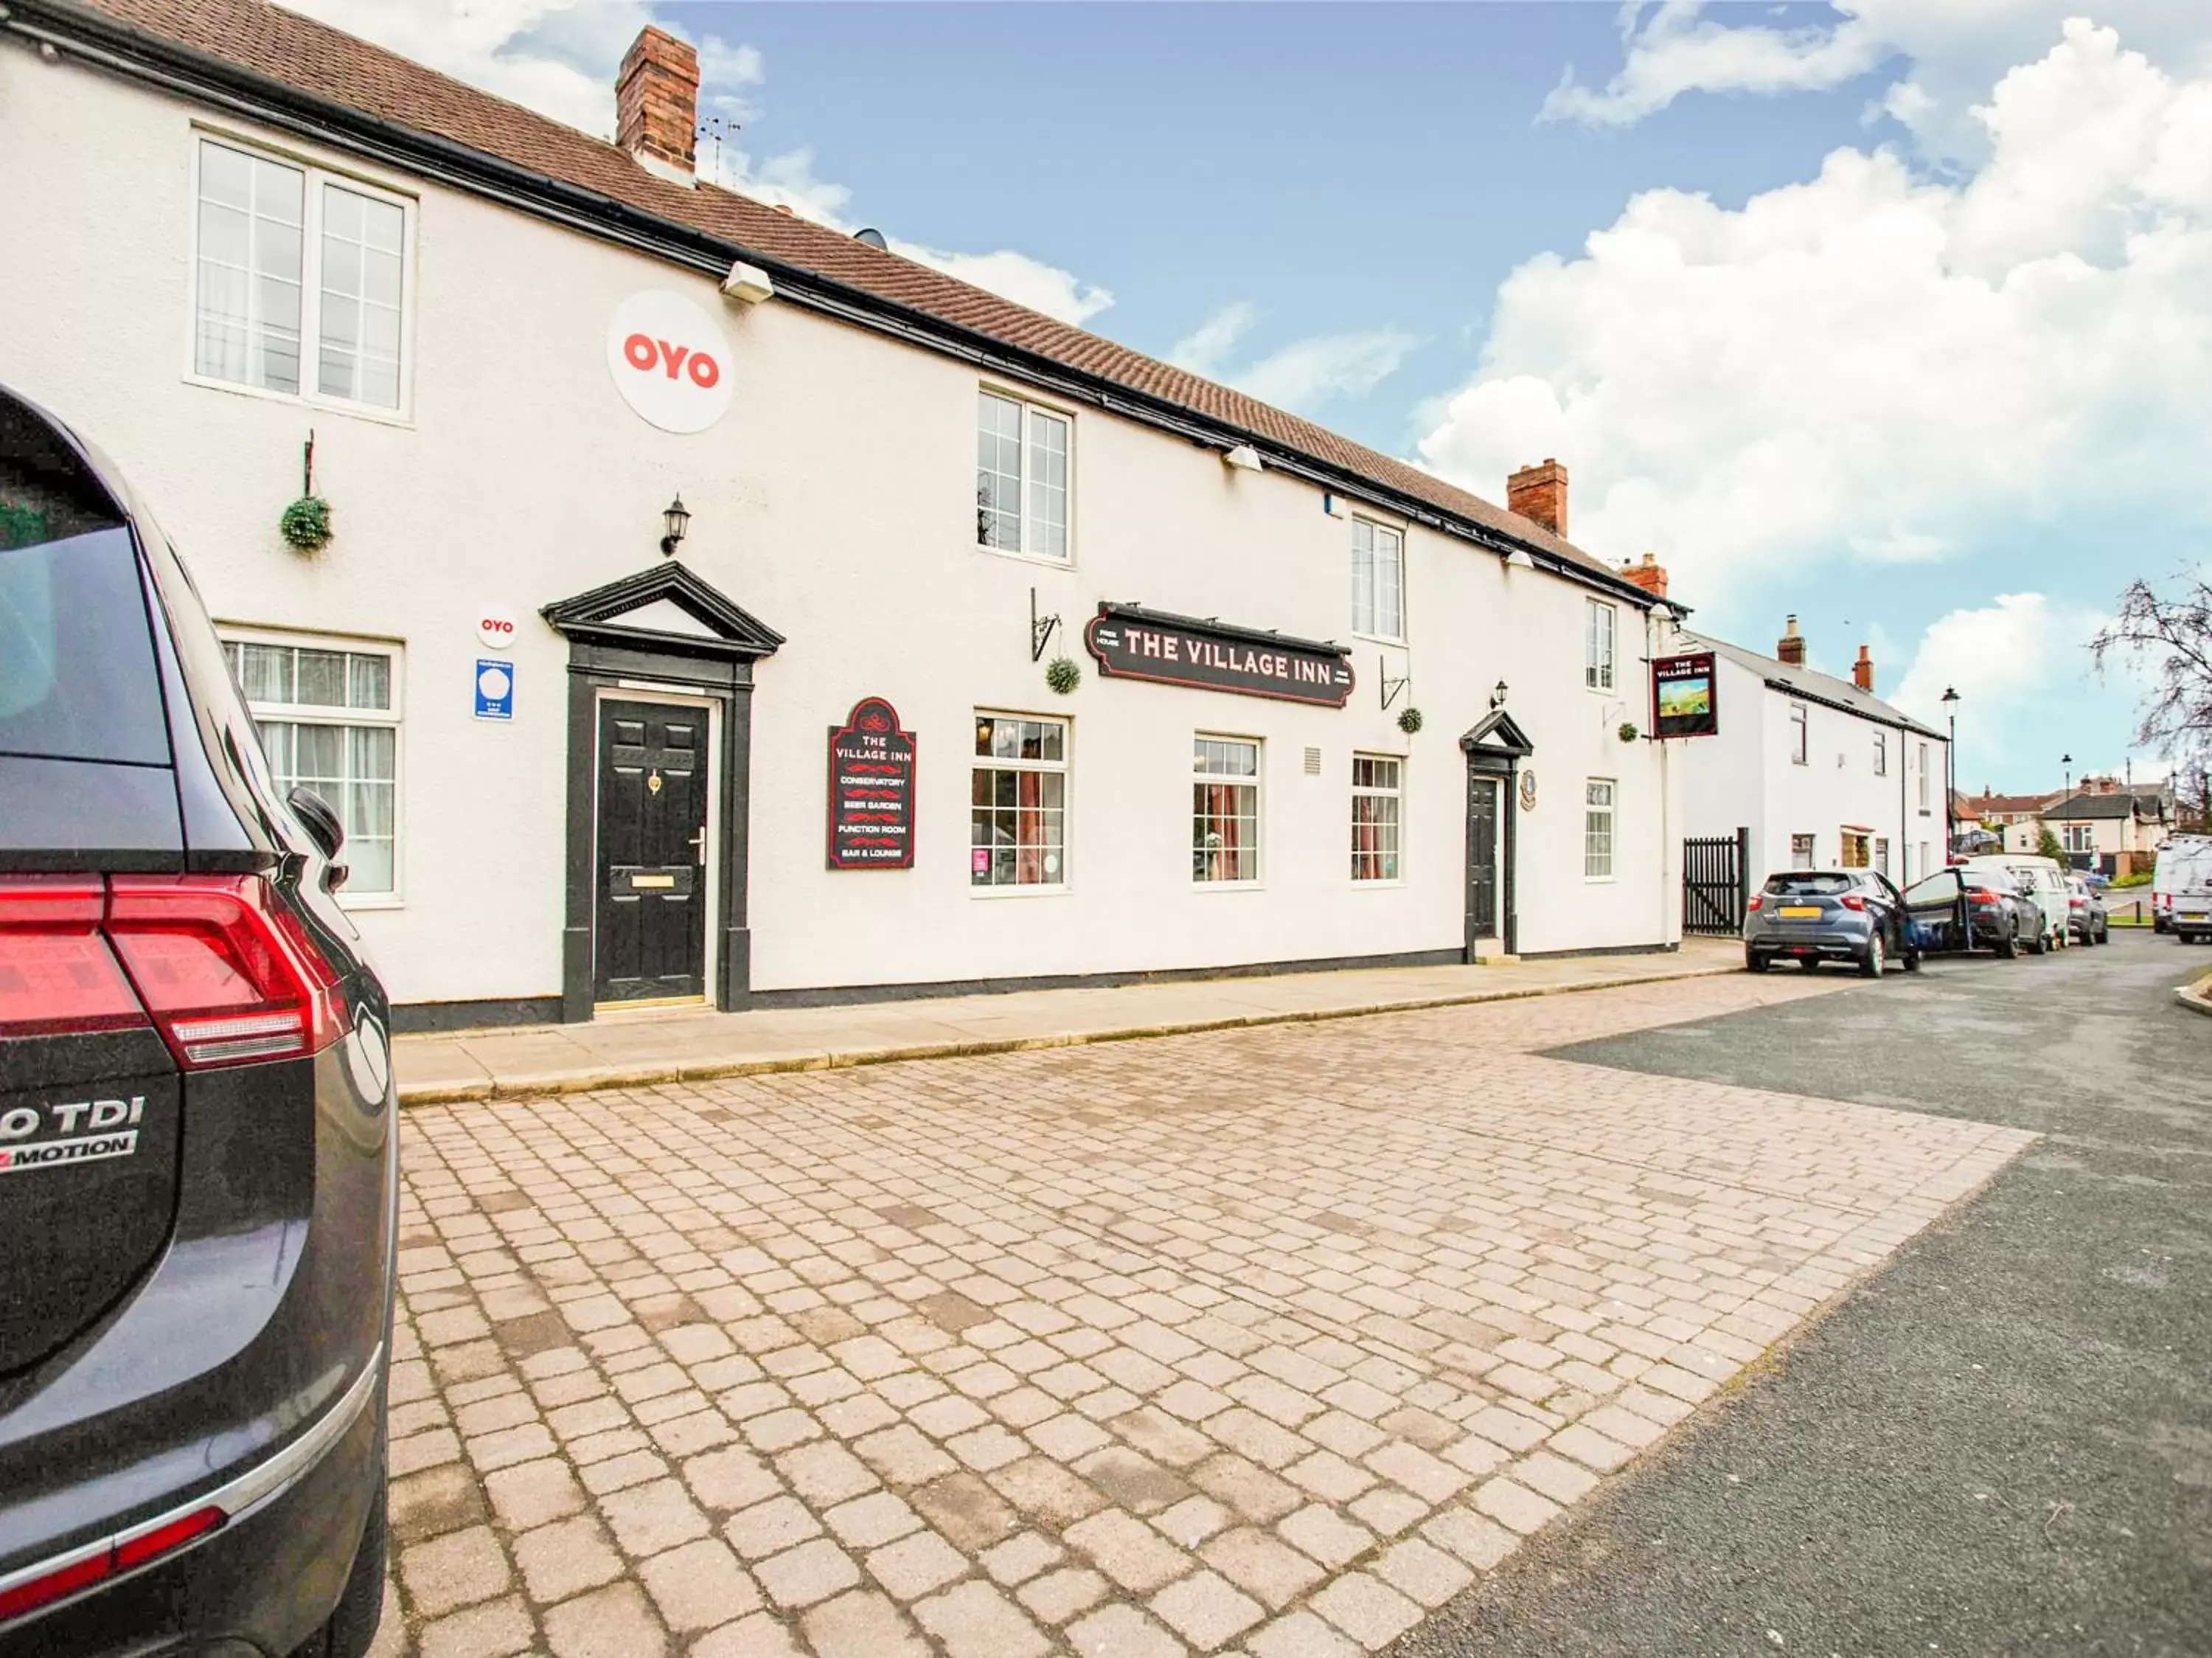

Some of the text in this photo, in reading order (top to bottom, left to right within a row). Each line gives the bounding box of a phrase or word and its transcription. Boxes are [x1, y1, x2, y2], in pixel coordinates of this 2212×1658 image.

[624, 333, 720, 389] OYO
[481, 619, 514, 634] OYO
[1124, 628, 1179, 662] THE
[1186, 640, 1288, 679] VILLAGE
[1294, 659, 1331, 685] INN
[1657, 668, 1691, 677] VILLAGE
[862, 735, 886, 747] THE
[835, 748, 911, 762] VILLAGE INN
[840, 776, 905, 787] CONSERVATORY
[844, 800, 902, 811] BEER GARDEN
[838, 825, 906, 834] FUNCTION ROOM
[841, 849, 860, 858] BAR
[869, 849, 902, 858] LOUNGE
[52, 1096, 145, 1134] TDI
